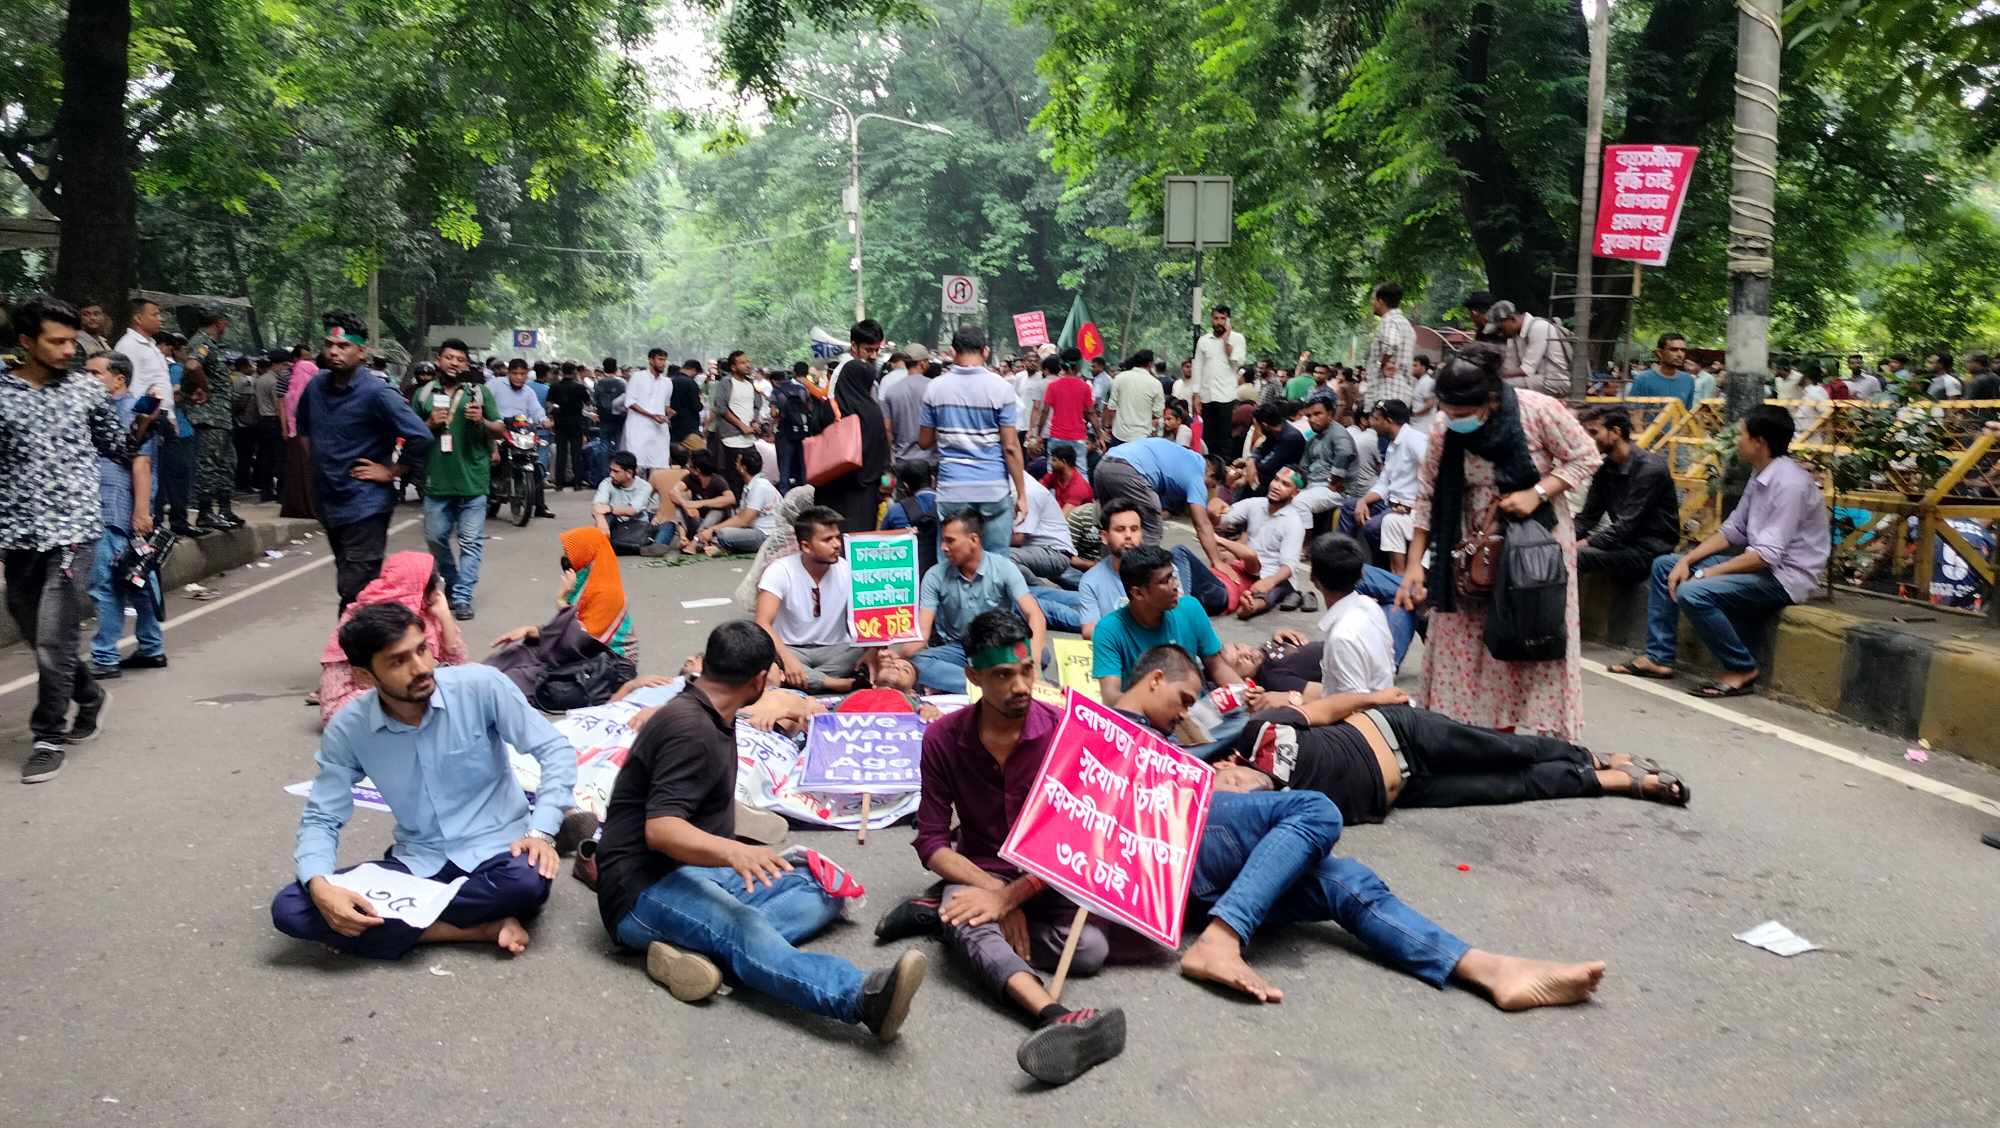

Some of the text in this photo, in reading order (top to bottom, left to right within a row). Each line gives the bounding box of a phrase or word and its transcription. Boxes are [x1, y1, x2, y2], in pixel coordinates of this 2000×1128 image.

[1615, 145, 1684, 167] বয়সসীমা
[1615, 193, 1670, 209] যোগ্যতা
[1601, 233, 1641, 255] সুযোগ
[855, 542, 908, 562] চাকরিতে
[851, 567, 912, 584] আবেদনের
[856, 584, 911, 605] বয়সসীমা
[855, 607, 918, 639] ৩৫ চাই
[836, 714, 897, 728] We
[821, 729, 923, 743] Want
[1074, 704, 1203, 784] যোগ্যতা প্রমাণের
[845, 742, 899, 754] No
[829, 757, 911, 769] Age
[1079, 746, 1172, 819] সুযোগ চাই
[1043, 774, 1119, 840] বয়সসীমা
[1055, 841, 1087, 876] ৩৫
